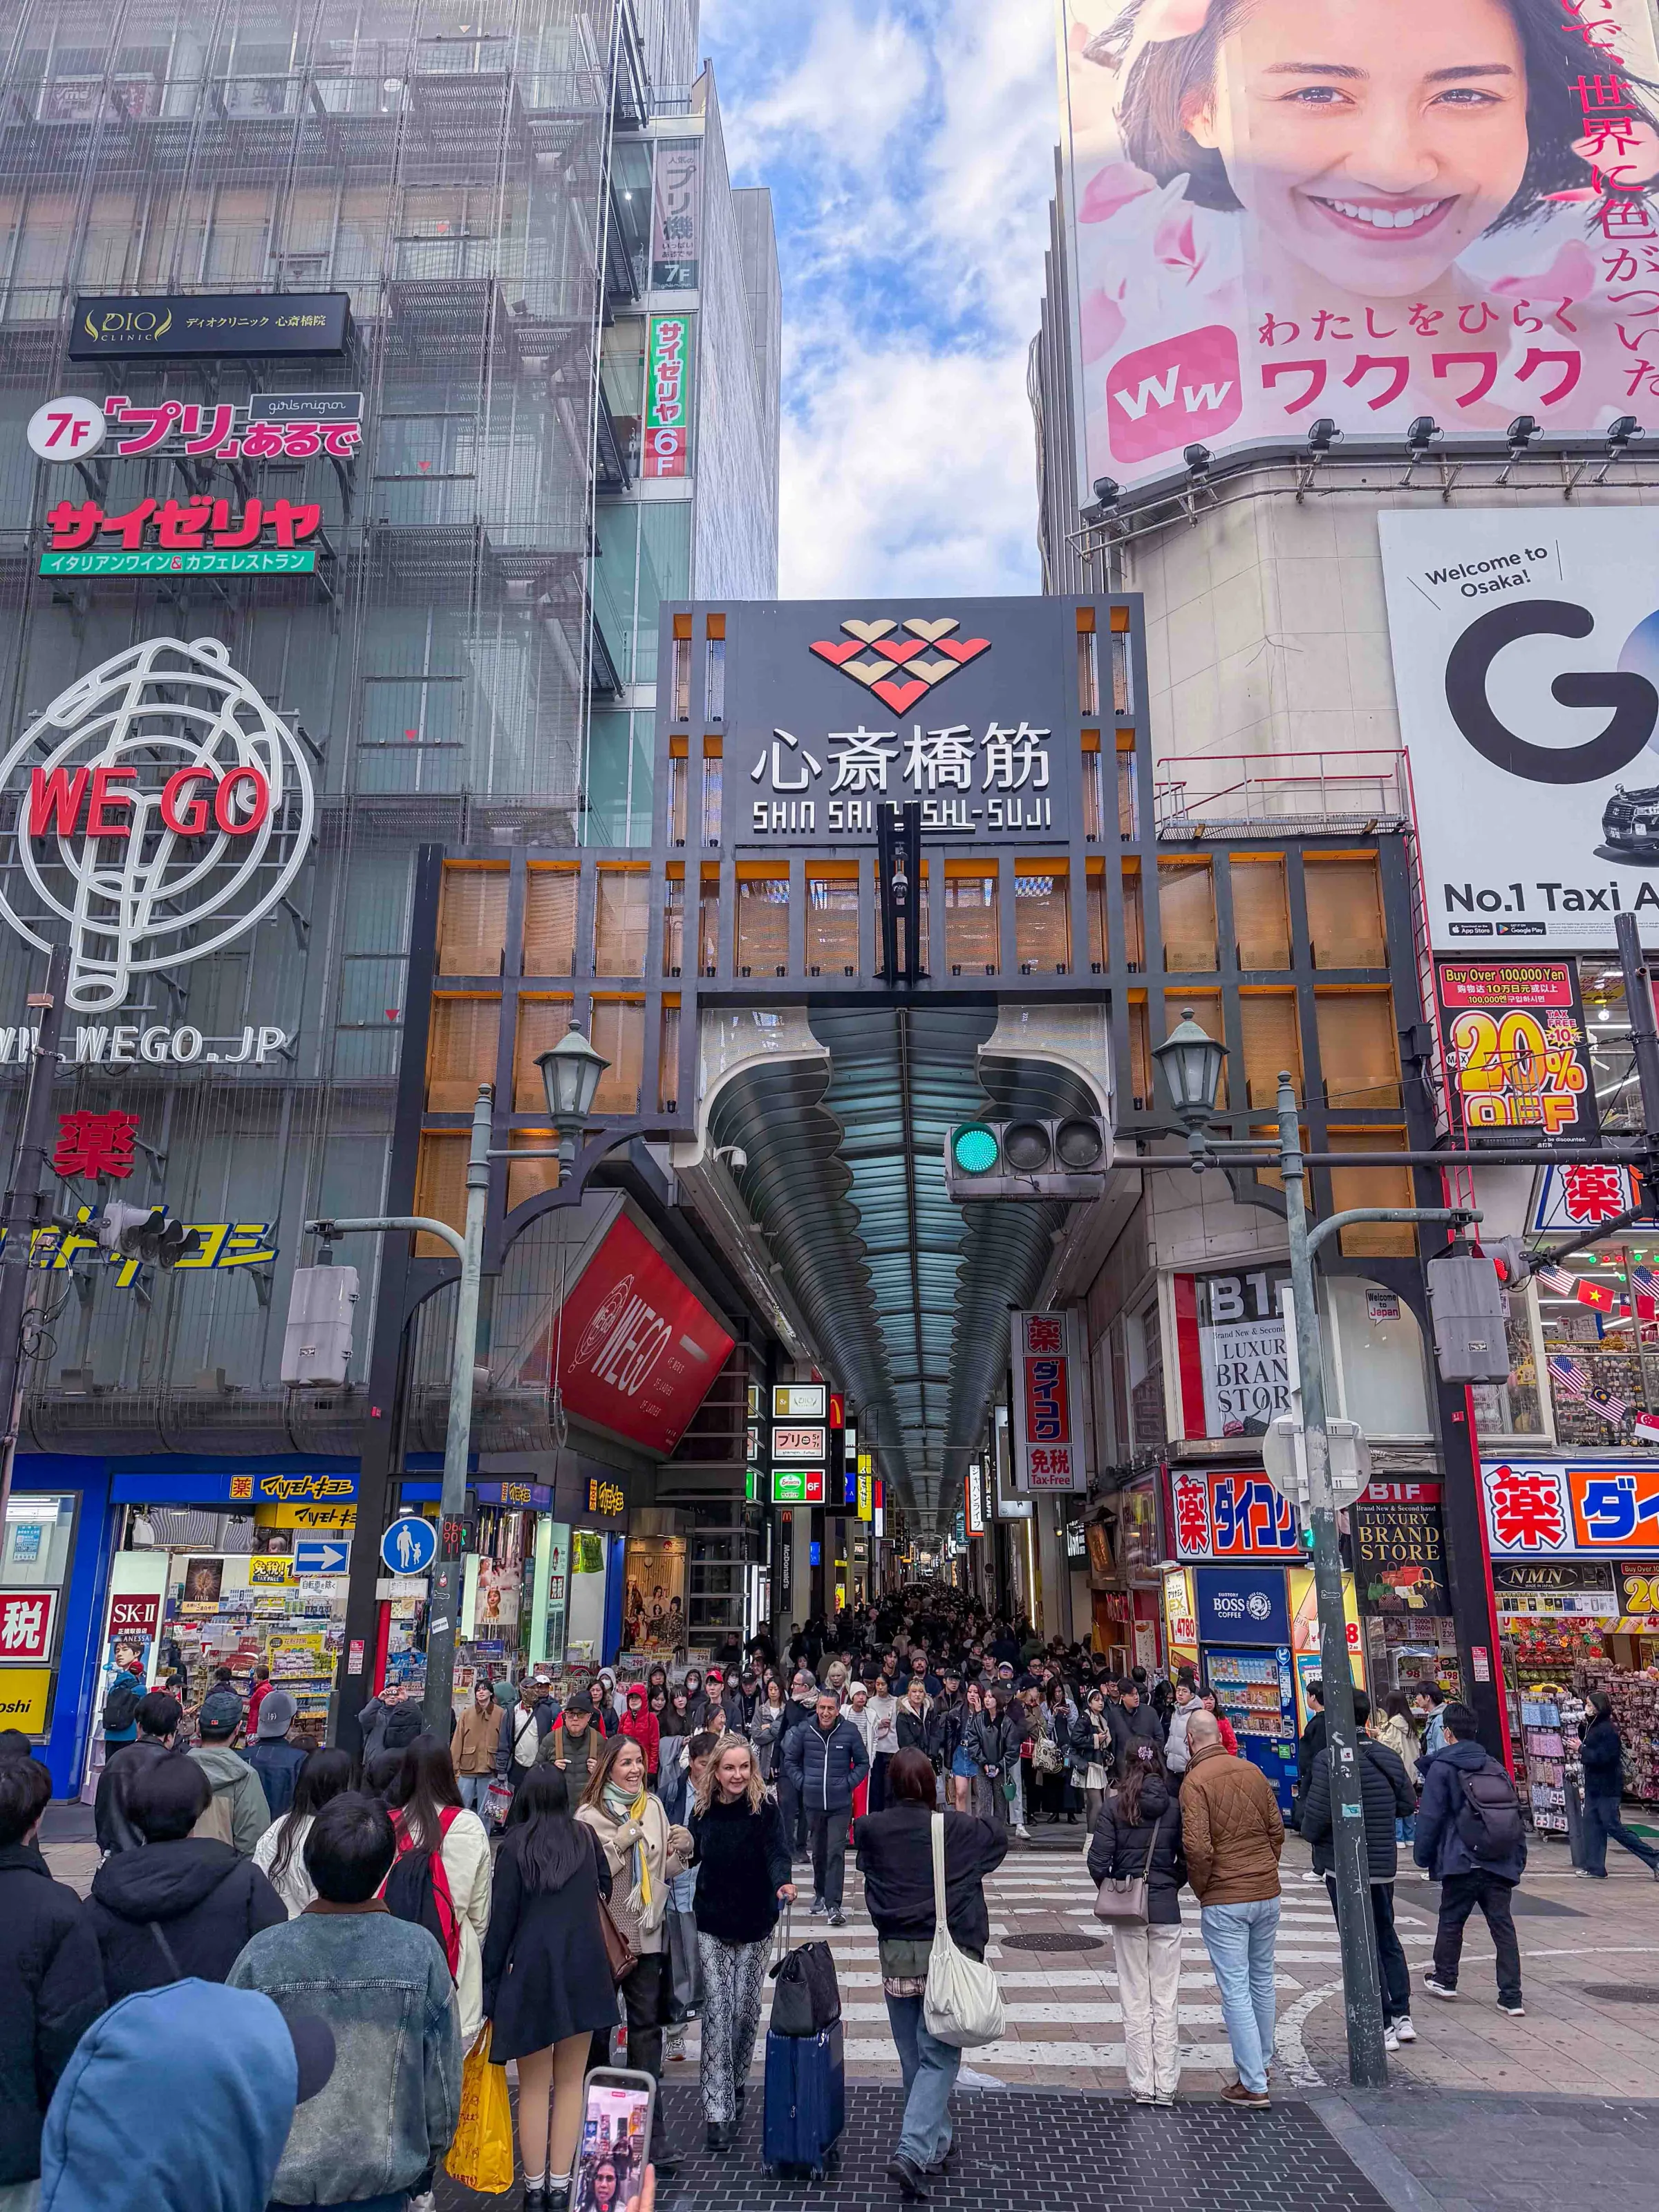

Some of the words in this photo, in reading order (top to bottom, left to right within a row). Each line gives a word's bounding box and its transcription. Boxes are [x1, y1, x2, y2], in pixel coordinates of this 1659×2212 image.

[664, 265, 689, 282] 7F
[186, 317, 269, 328] ディオクリニック
[275, 315, 326, 327] 心斎橋院
[1259, 299, 1579, 346] わたしをひらく
[656, 323, 682, 422] サイゼリヤ
[1261, 348, 1582, 415] ワクワク
[45, 413, 91, 447] 7F
[47, 496, 321, 550] サイゼリヤ
[1425, 551, 1522, 586] Welcome
[1525, 545, 1548, 561] to
[1461, 569, 1531, 597] Osaka!
[751, 722, 1051, 793] 心斎橋筋
[753, 801, 814, 830] SHIN
[1444, 883, 1525, 912] No.1
[1537, 881, 1621, 912] Taxi
[1446, 969, 1466, 982] Buy
[1470, 969, 1496, 981] Over
[1500, 968, 1541, 982] 100,000
[1544, 969, 1564, 981] Yen
[1546, 1010, 1568, 1018] TAX
[1548, 1019, 1577, 1027] FREE
[1447, 1055, 1467, 1064] MAX
[1469, 1096, 1577, 1132] OFF
[54, 1110, 140, 1179] 薬
[1562, 1165, 1622, 1221] 薬
[1368, 1293, 1396, 1302] Welcome
[1369, 1307, 1398, 1318] Japan
[591, 1294, 672, 1396] WEGO
[1027, 1315, 1062, 1352] 薬
[1212, 1330, 1233, 1340] Brand
[1236, 1329, 1250, 1338] New
[1223, 1339, 1286, 1359] LUXUR
[1214, 1358, 1289, 1387] BRAN
[1033, 1360, 1060, 1440] ダイコク
[1218, 1385, 1291, 1412] STOR
[1031, 1449, 1069, 1474] 免税
[233, 1478, 251, 1496] 薬
[261, 1475, 353, 1499] マツモトキヨシ
[807, 1482, 819, 1491] 6F
[1032, 1474, 1070, 1485] Tax-Free
[1178, 1476, 1208, 1552] 薬
[1365, 1513, 1429, 1524] LUXURY
[1489, 1466, 1563, 1546] 薬
[1358, 1526, 1439, 1542] BRAND
[1361, 1544, 1439, 1560] STORE
[303, 1580, 336, 1589] 自転車を除く
[1508, 1568, 1564, 1584] NMN
[1213, 1598, 1245, 1611] BOSS
[1, 1600, 44, 1649] 税
[1177, 1618, 1194, 1638] 4780
